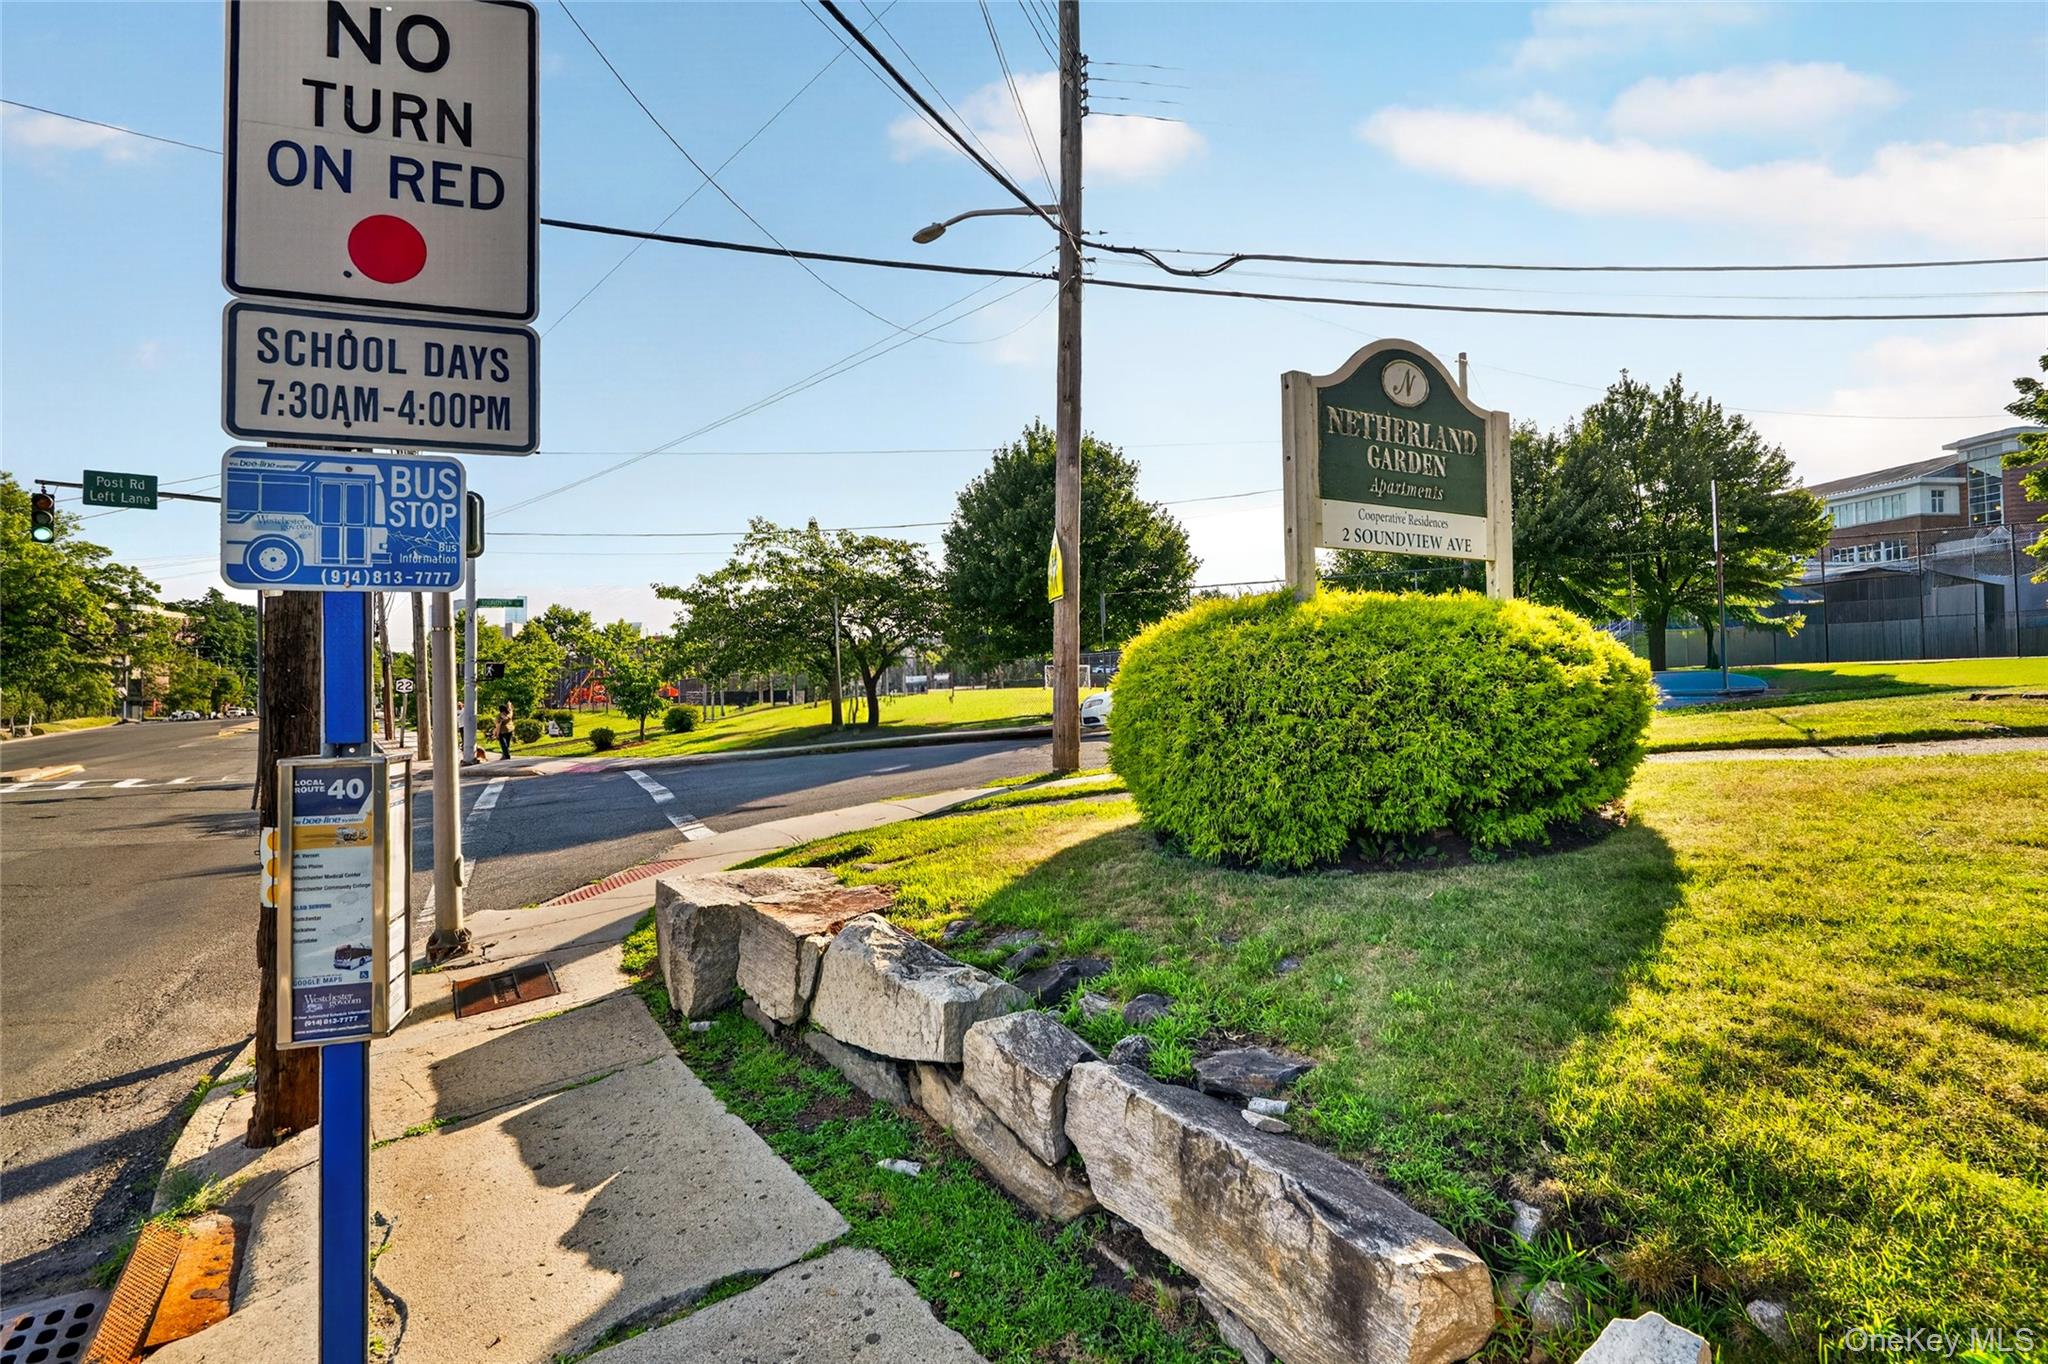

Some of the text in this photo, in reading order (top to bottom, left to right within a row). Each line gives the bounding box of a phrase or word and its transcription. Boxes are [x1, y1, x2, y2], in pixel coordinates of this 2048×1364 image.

[327, 0, 450, 73] NO
[302, 78, 472, 148] TURN
[267, 140, 505, 210] ON RED
[257, 327, 510, 383] SCHOOL DAYS
[1392, 369, 1416, 396] N
[257, 378, 511, 431] 7:30AM-4:00PM
[1326, 405, 1478, 457] NETHERLAND
[1367, 445, 1447, 478] GARDEN
[96, 476, 145, 490] Post Rd
[390, 466, 457, 499] BUS
[1369, 476, 1444, 501] Apartments
[90, 490, 150, 504] Left Lane
[389, 501, 457, 529] STOP
[1358, 507, 1449, 529] Cooperative Residences
[438, 542, 457, 553] Bus
[1342, 527, 1472, 553] 2 SOUNDVIEW AVE
[399, 553, 457, 565] Information
[397, 681, 412, 691] 22
[327, 778, 364, 799] 40
